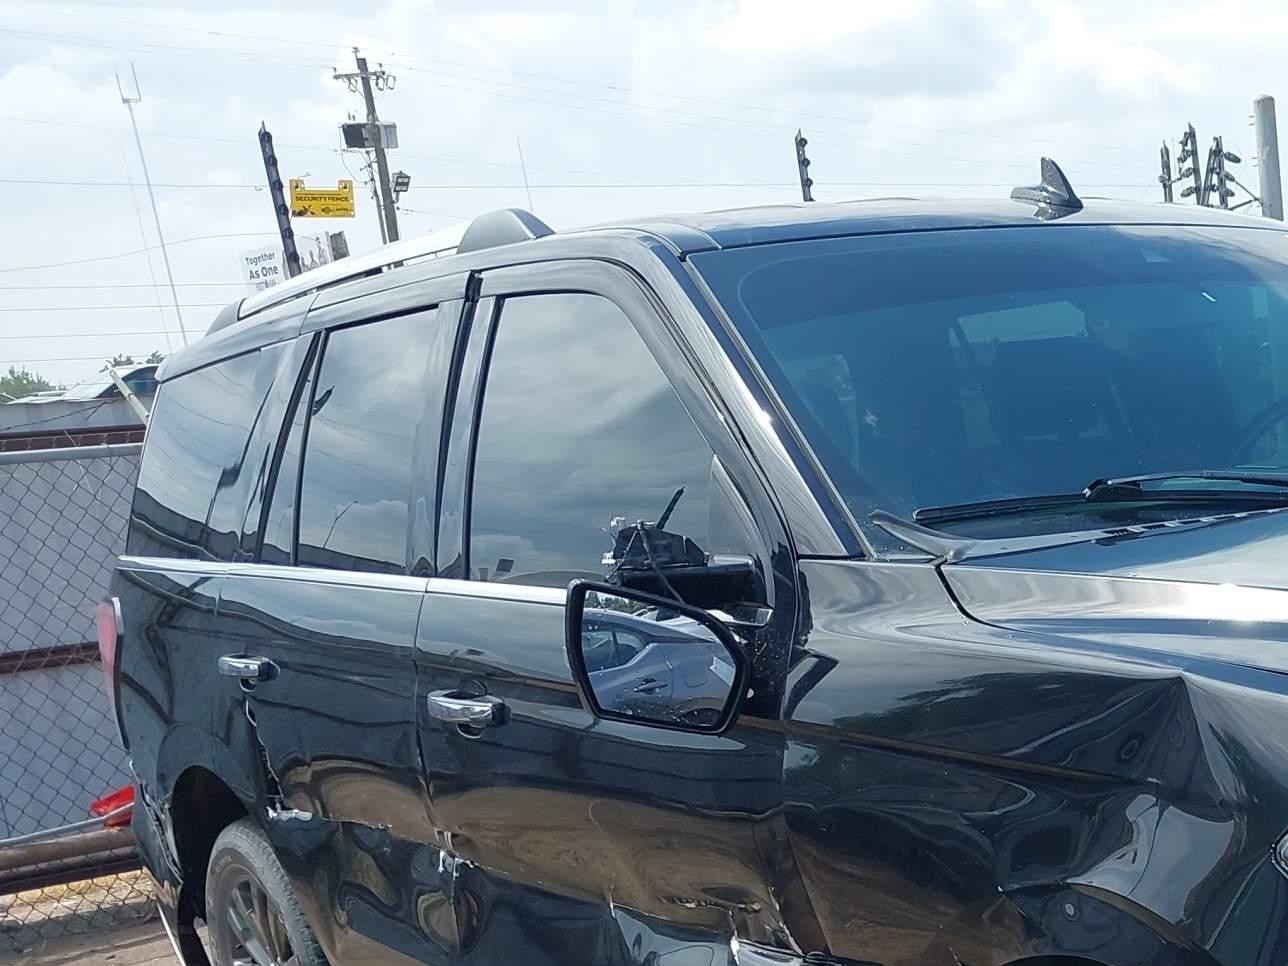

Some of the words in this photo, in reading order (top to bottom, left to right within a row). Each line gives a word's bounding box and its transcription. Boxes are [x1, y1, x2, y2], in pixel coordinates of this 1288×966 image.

[245, 252, 275, 266] Together
[249, 269, 260, 280] As
[261, 265, 279, 277] One
